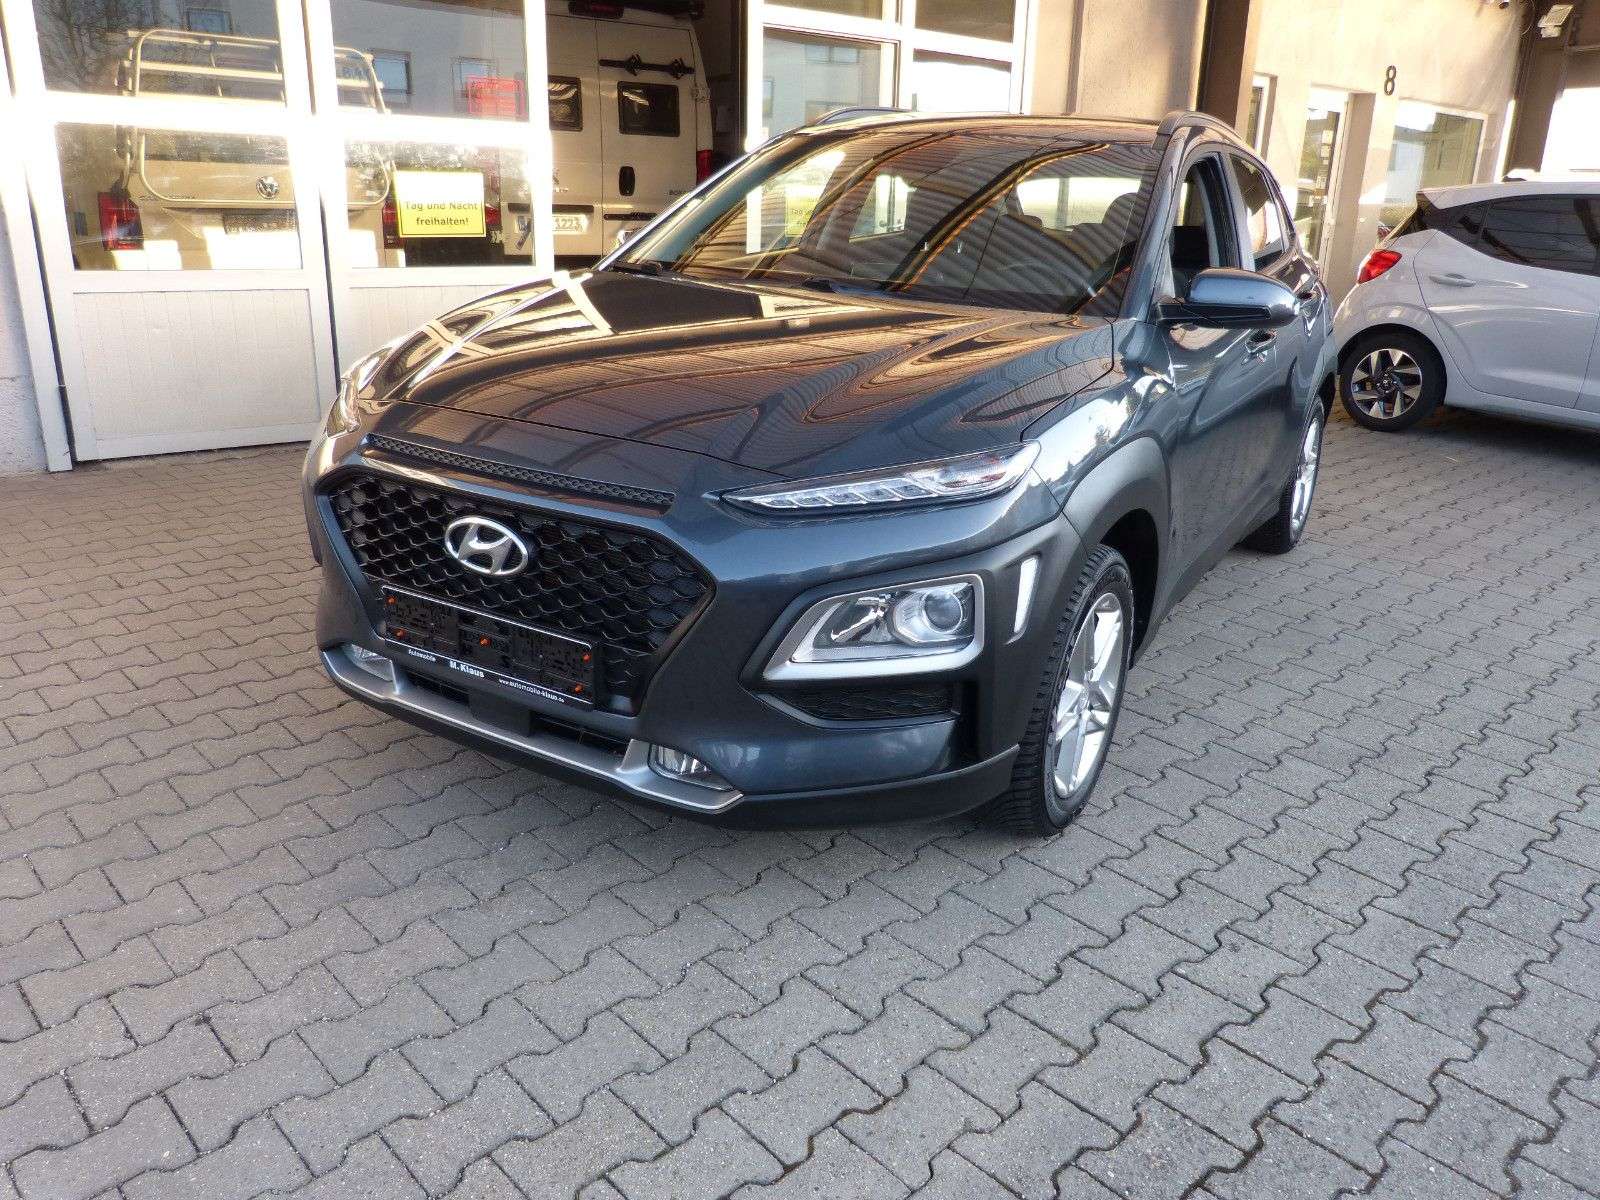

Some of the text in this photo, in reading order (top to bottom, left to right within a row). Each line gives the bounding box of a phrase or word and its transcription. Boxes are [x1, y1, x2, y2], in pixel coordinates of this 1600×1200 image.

[1384, 65, 1397, 96] 8
[405, 201, 478, 212] Tag und Nacht
[416, 216, 469, 226] freihalten!
[460, 663, 485, 678] Klaus
